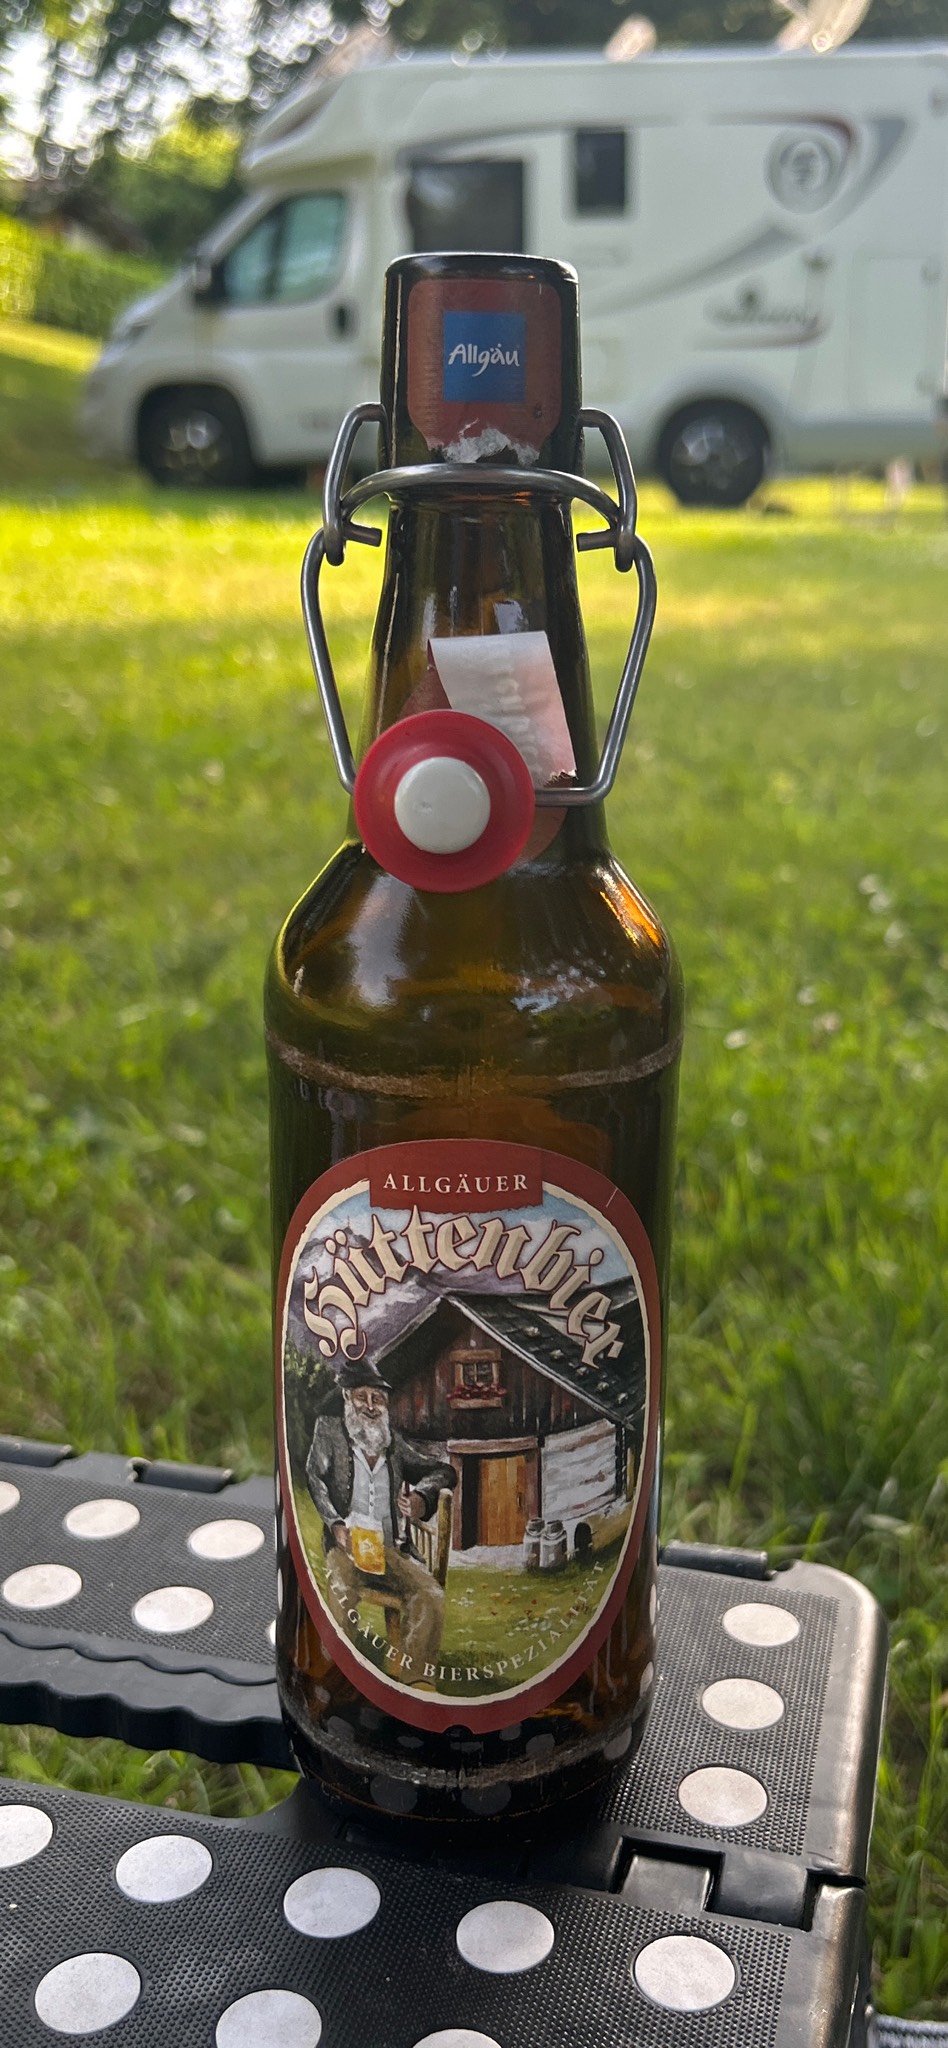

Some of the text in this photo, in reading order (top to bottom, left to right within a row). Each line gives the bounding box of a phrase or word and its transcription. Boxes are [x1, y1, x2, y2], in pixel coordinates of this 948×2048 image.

[448, 343, 520, 377] Allgäu
[383, 1173, 529, 1194] ALLGÄUER
[303, 1204, 624, 1369] Hüttenbier
[321, 1560, 604, 1682] ALLGÄUER BIERSPEZIALITÄT
